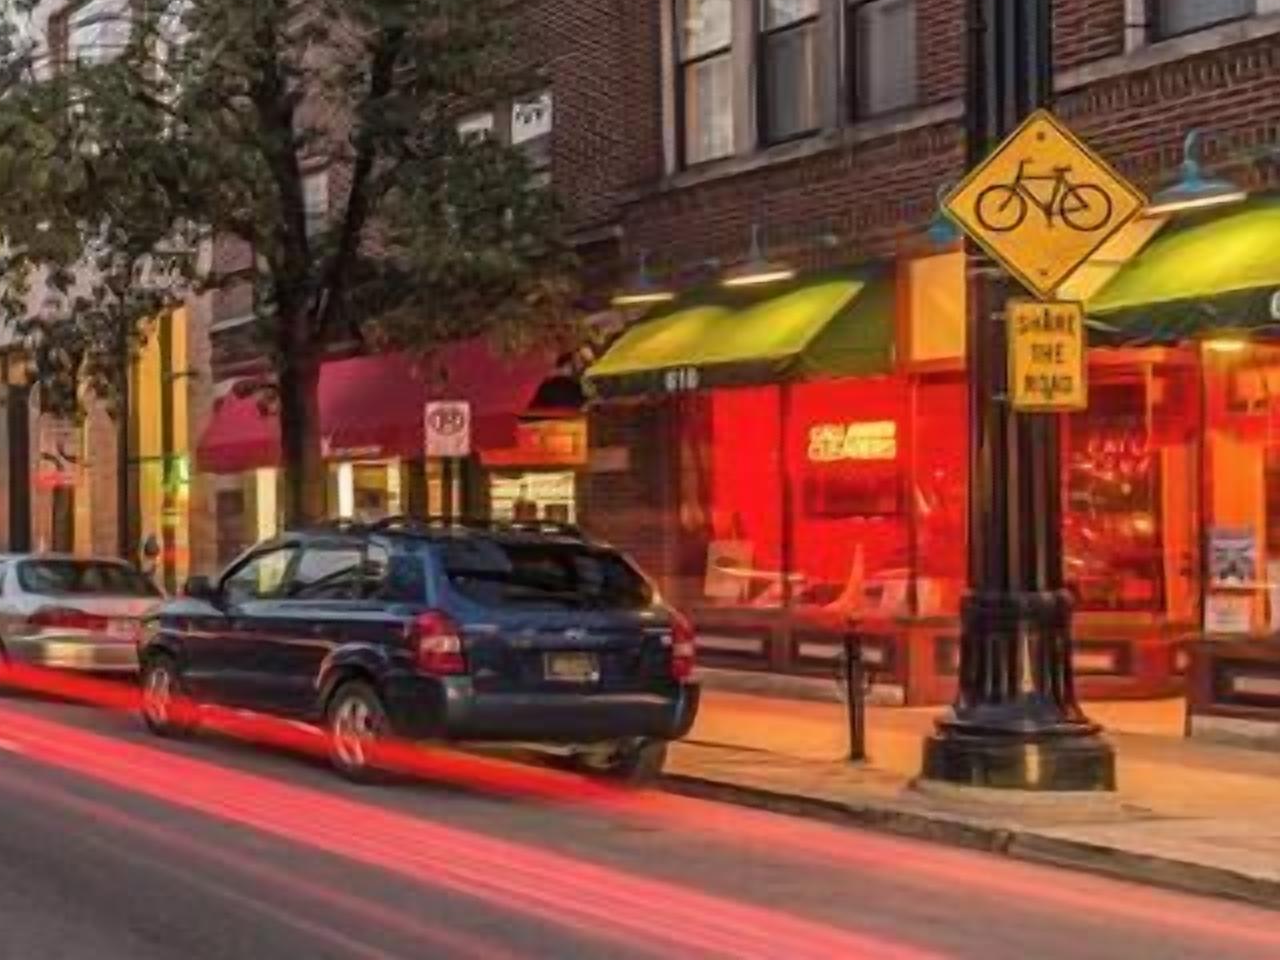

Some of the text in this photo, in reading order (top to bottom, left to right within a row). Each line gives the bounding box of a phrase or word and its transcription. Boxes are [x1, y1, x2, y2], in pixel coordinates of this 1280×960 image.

[1017, 308, 1076, 337] SHARE
[1031, 342, 1066, 365] THE
[1023, 373, 1074, 400] ROAD
